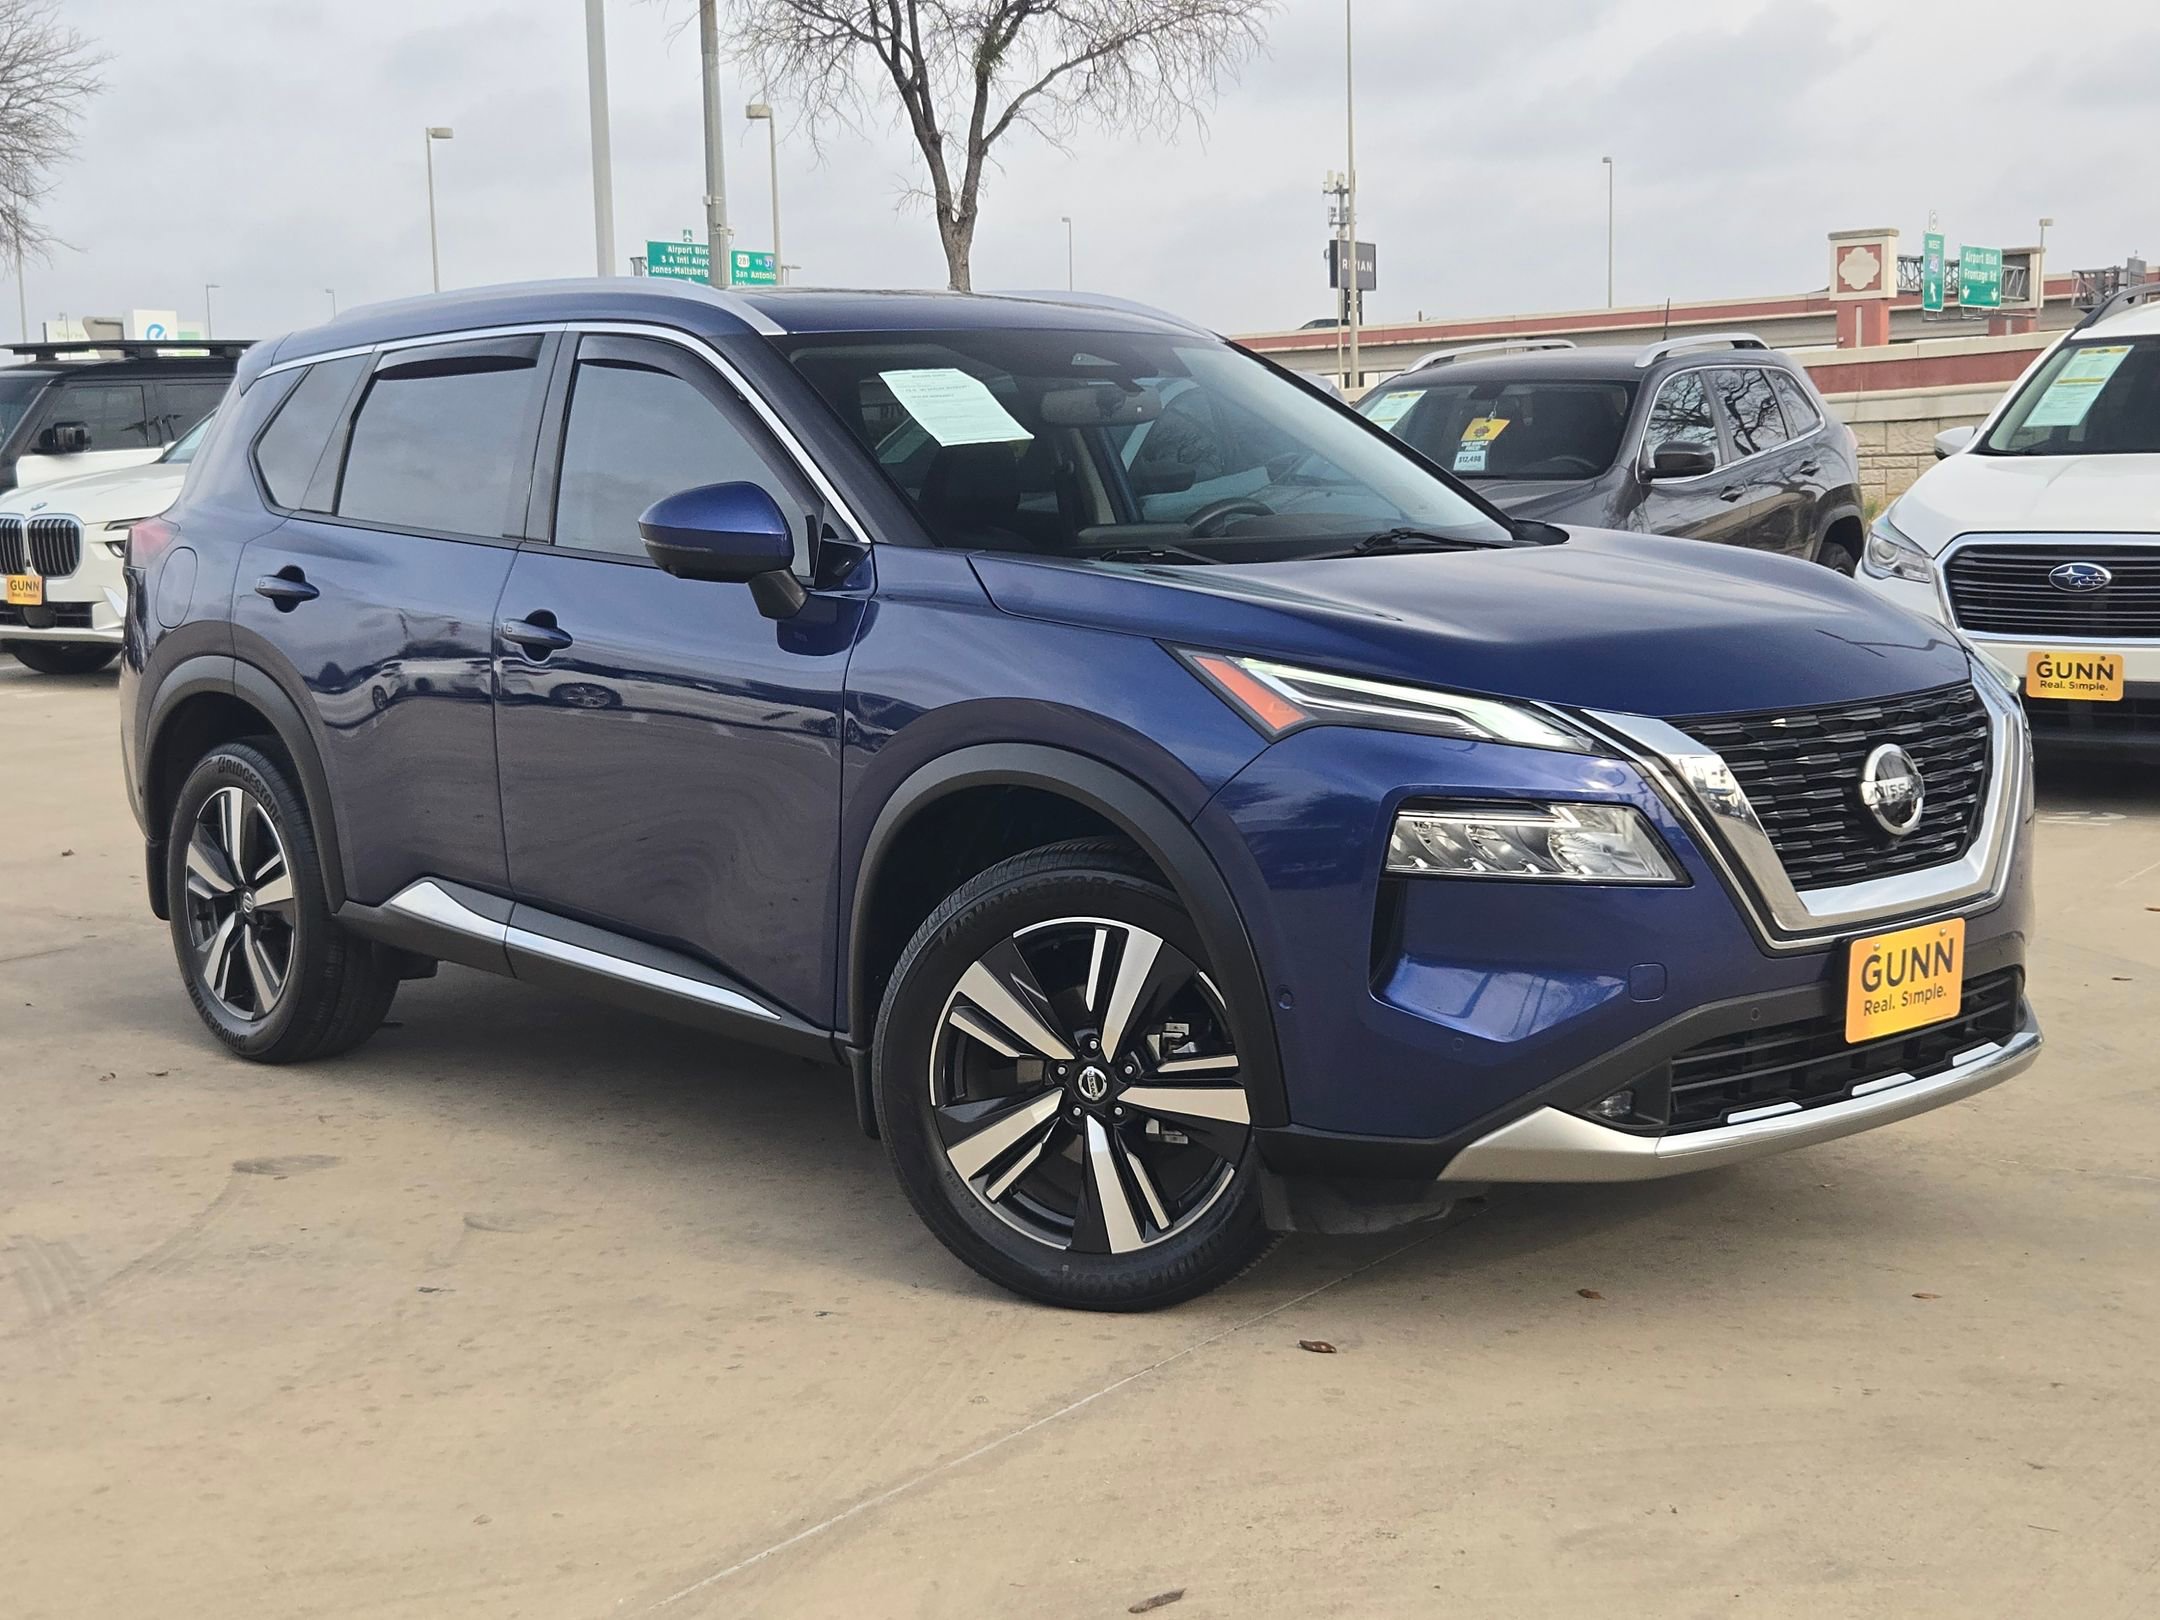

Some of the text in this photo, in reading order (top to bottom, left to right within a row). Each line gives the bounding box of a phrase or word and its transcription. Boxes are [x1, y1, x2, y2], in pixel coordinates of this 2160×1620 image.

[667, 245, 692, 255] Airport
[661, 255, 666, 263] S
[669, 256, 675, 264] A
[1965, 250, 1997, 265] Airport Blvd
[735, 270, 776, 280] San Antonio
[1964, 268, 1997, 284] Frontage Rd
[10, 580, 40, 591] GUNN
[2036, 661, 2114, 680] GUNN
[2040, 680, 2108, 691] Real. Simple.
[1861, 937, 1955, 993] GUNN
[1863, 983, 1947, 1017] Real. Simple.
